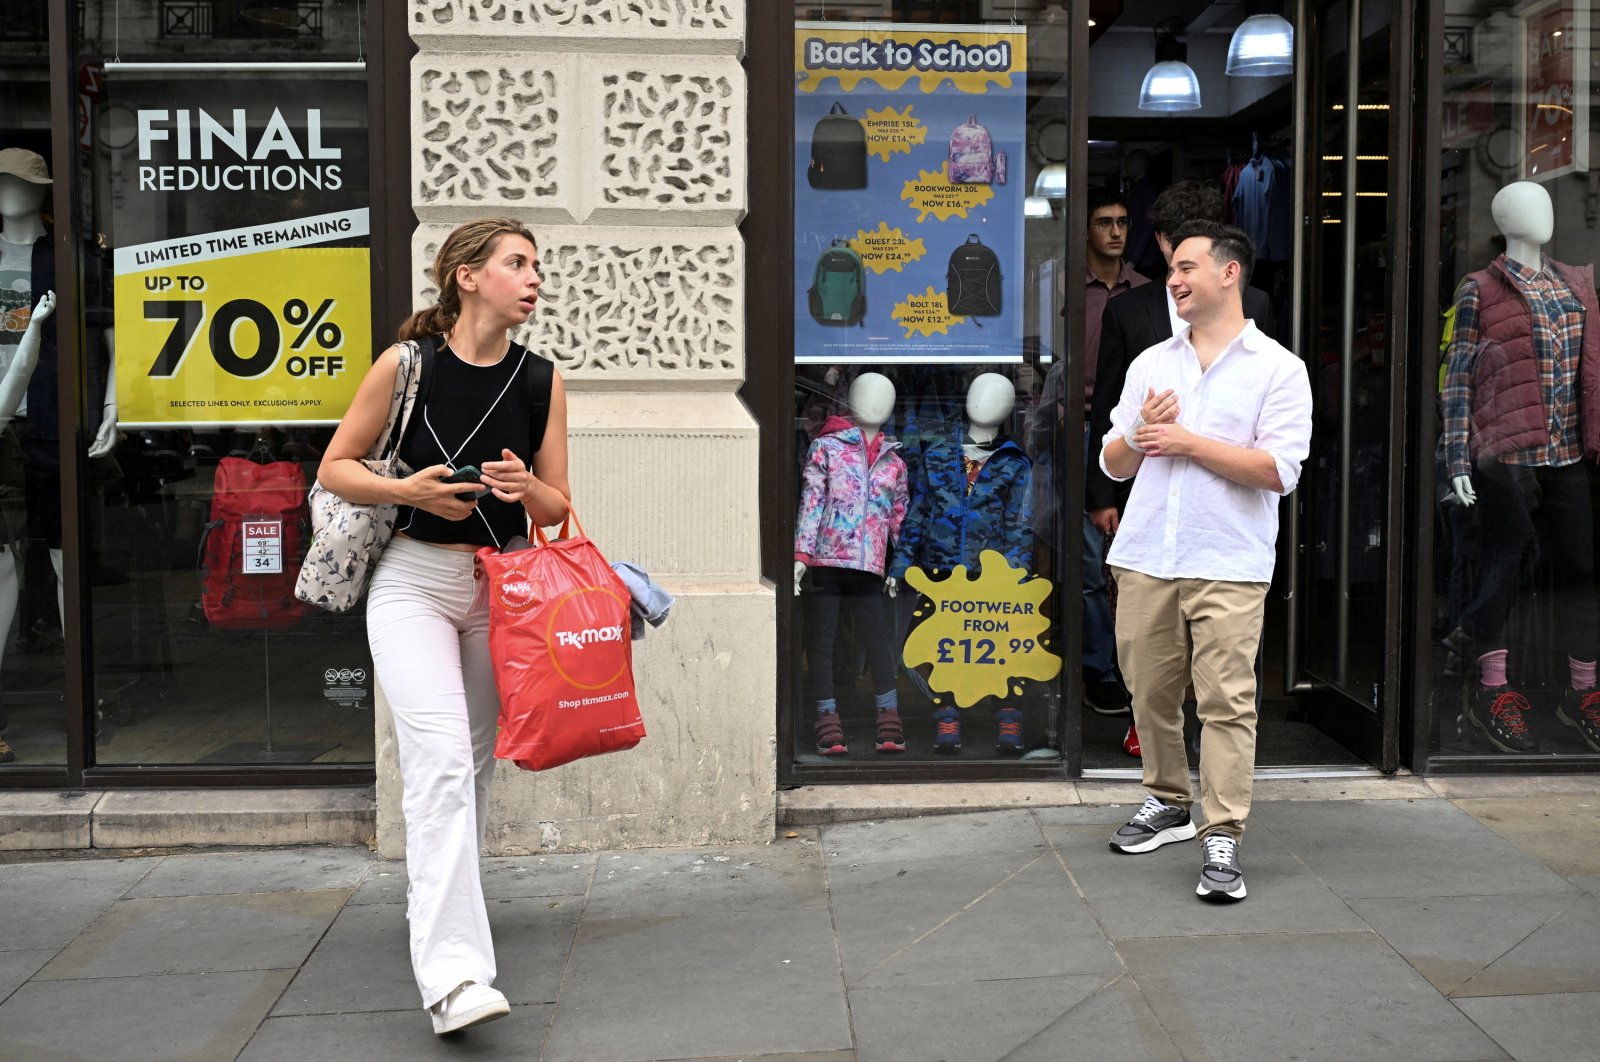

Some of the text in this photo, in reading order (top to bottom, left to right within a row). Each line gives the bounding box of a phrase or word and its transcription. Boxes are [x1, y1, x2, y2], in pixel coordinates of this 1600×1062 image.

[809, 41, 1008, 66] Back to School
[867, 120, 900, 128] EMPRISE
[137, 106, 342, 161] FINAL
[139, 165, 342, 191] REDUCTIONS
[914, 185, 962, 193] BOOKWORM
[946, 200, 970, 208] £16.99
[135, 218, 352, 265] LIMITED TIME REMAINING
[144, 276, 207, 292] UP TO
[143, 298, 343, 379] 70%
[286, 356, 344, 378] OFF
[170, 400, 206, 408] SELECTED
[253, 399, 298, 407] EXCLUSIONS
[248, 526, 277, 535] SALE
[502, 582, 531, 595] 94%
[941, 600, 1034, 615] FOOTWEAR
[963, 619, 1009, 632] FROM
[937, 638, 1035, 665] £12.99
[558, 691, 629, 709] Shop tkmaxx.com
